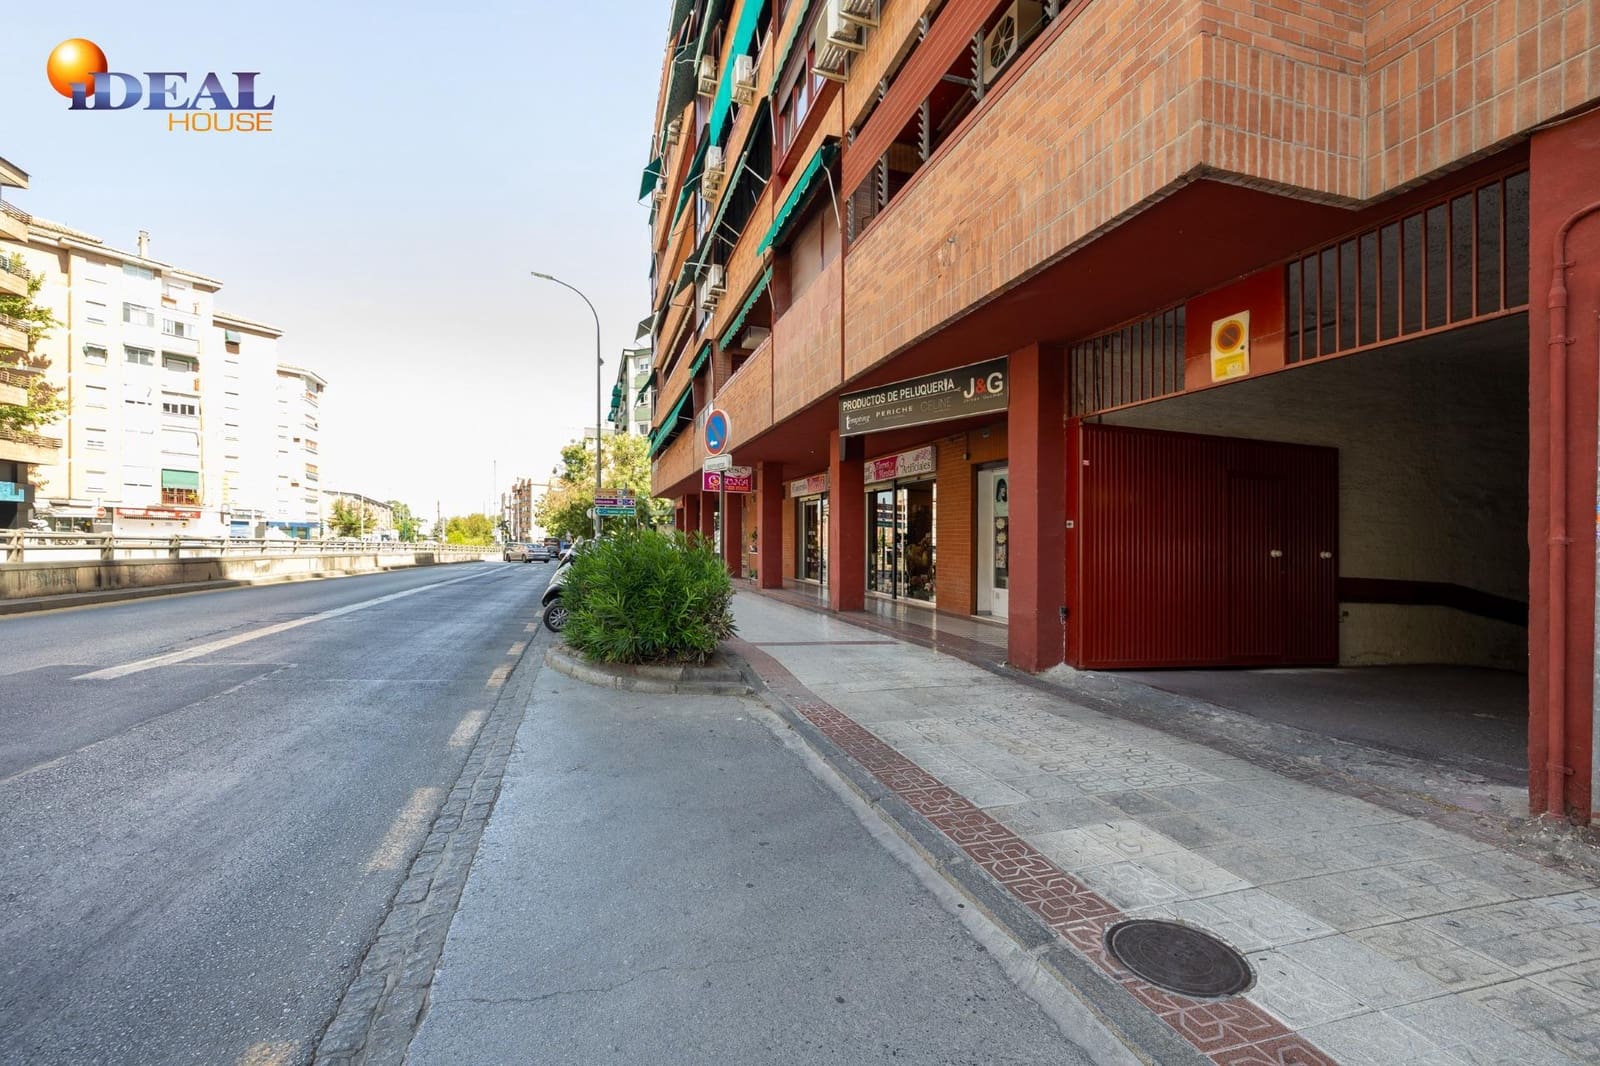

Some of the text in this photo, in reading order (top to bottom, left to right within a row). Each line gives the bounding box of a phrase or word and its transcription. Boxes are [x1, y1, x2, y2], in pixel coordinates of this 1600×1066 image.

[963, 371, 1004, 399] J&G
[843, 393, 886, 411] PRODUCTOS
[887, 390, 898, 402] DE
[875, 405, 913, 418] PERICHE
